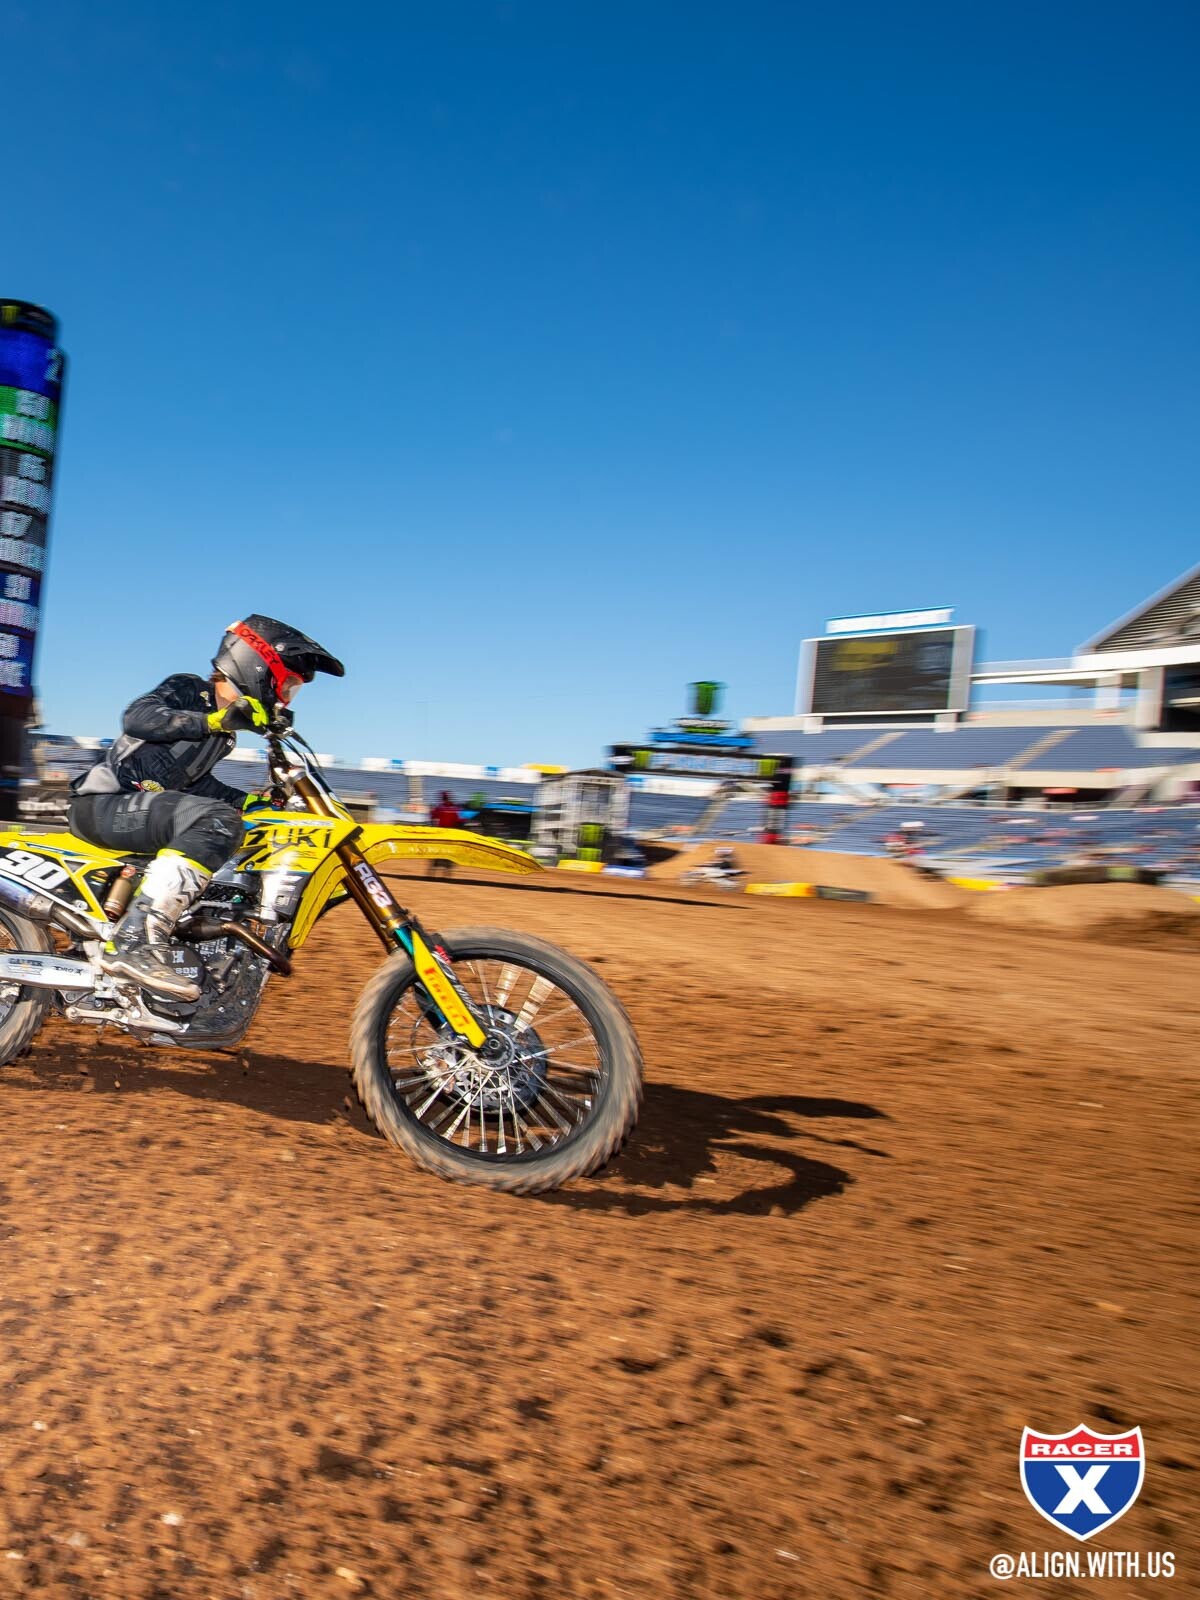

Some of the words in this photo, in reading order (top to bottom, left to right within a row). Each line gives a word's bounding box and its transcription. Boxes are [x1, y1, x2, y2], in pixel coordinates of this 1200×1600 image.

[241, 629, 280, 664] OAKLEY
[241, 828, 332, 849] ZUKI
[353, 862, 393, 908] RG3
[175, 966, 199, 975] SON
